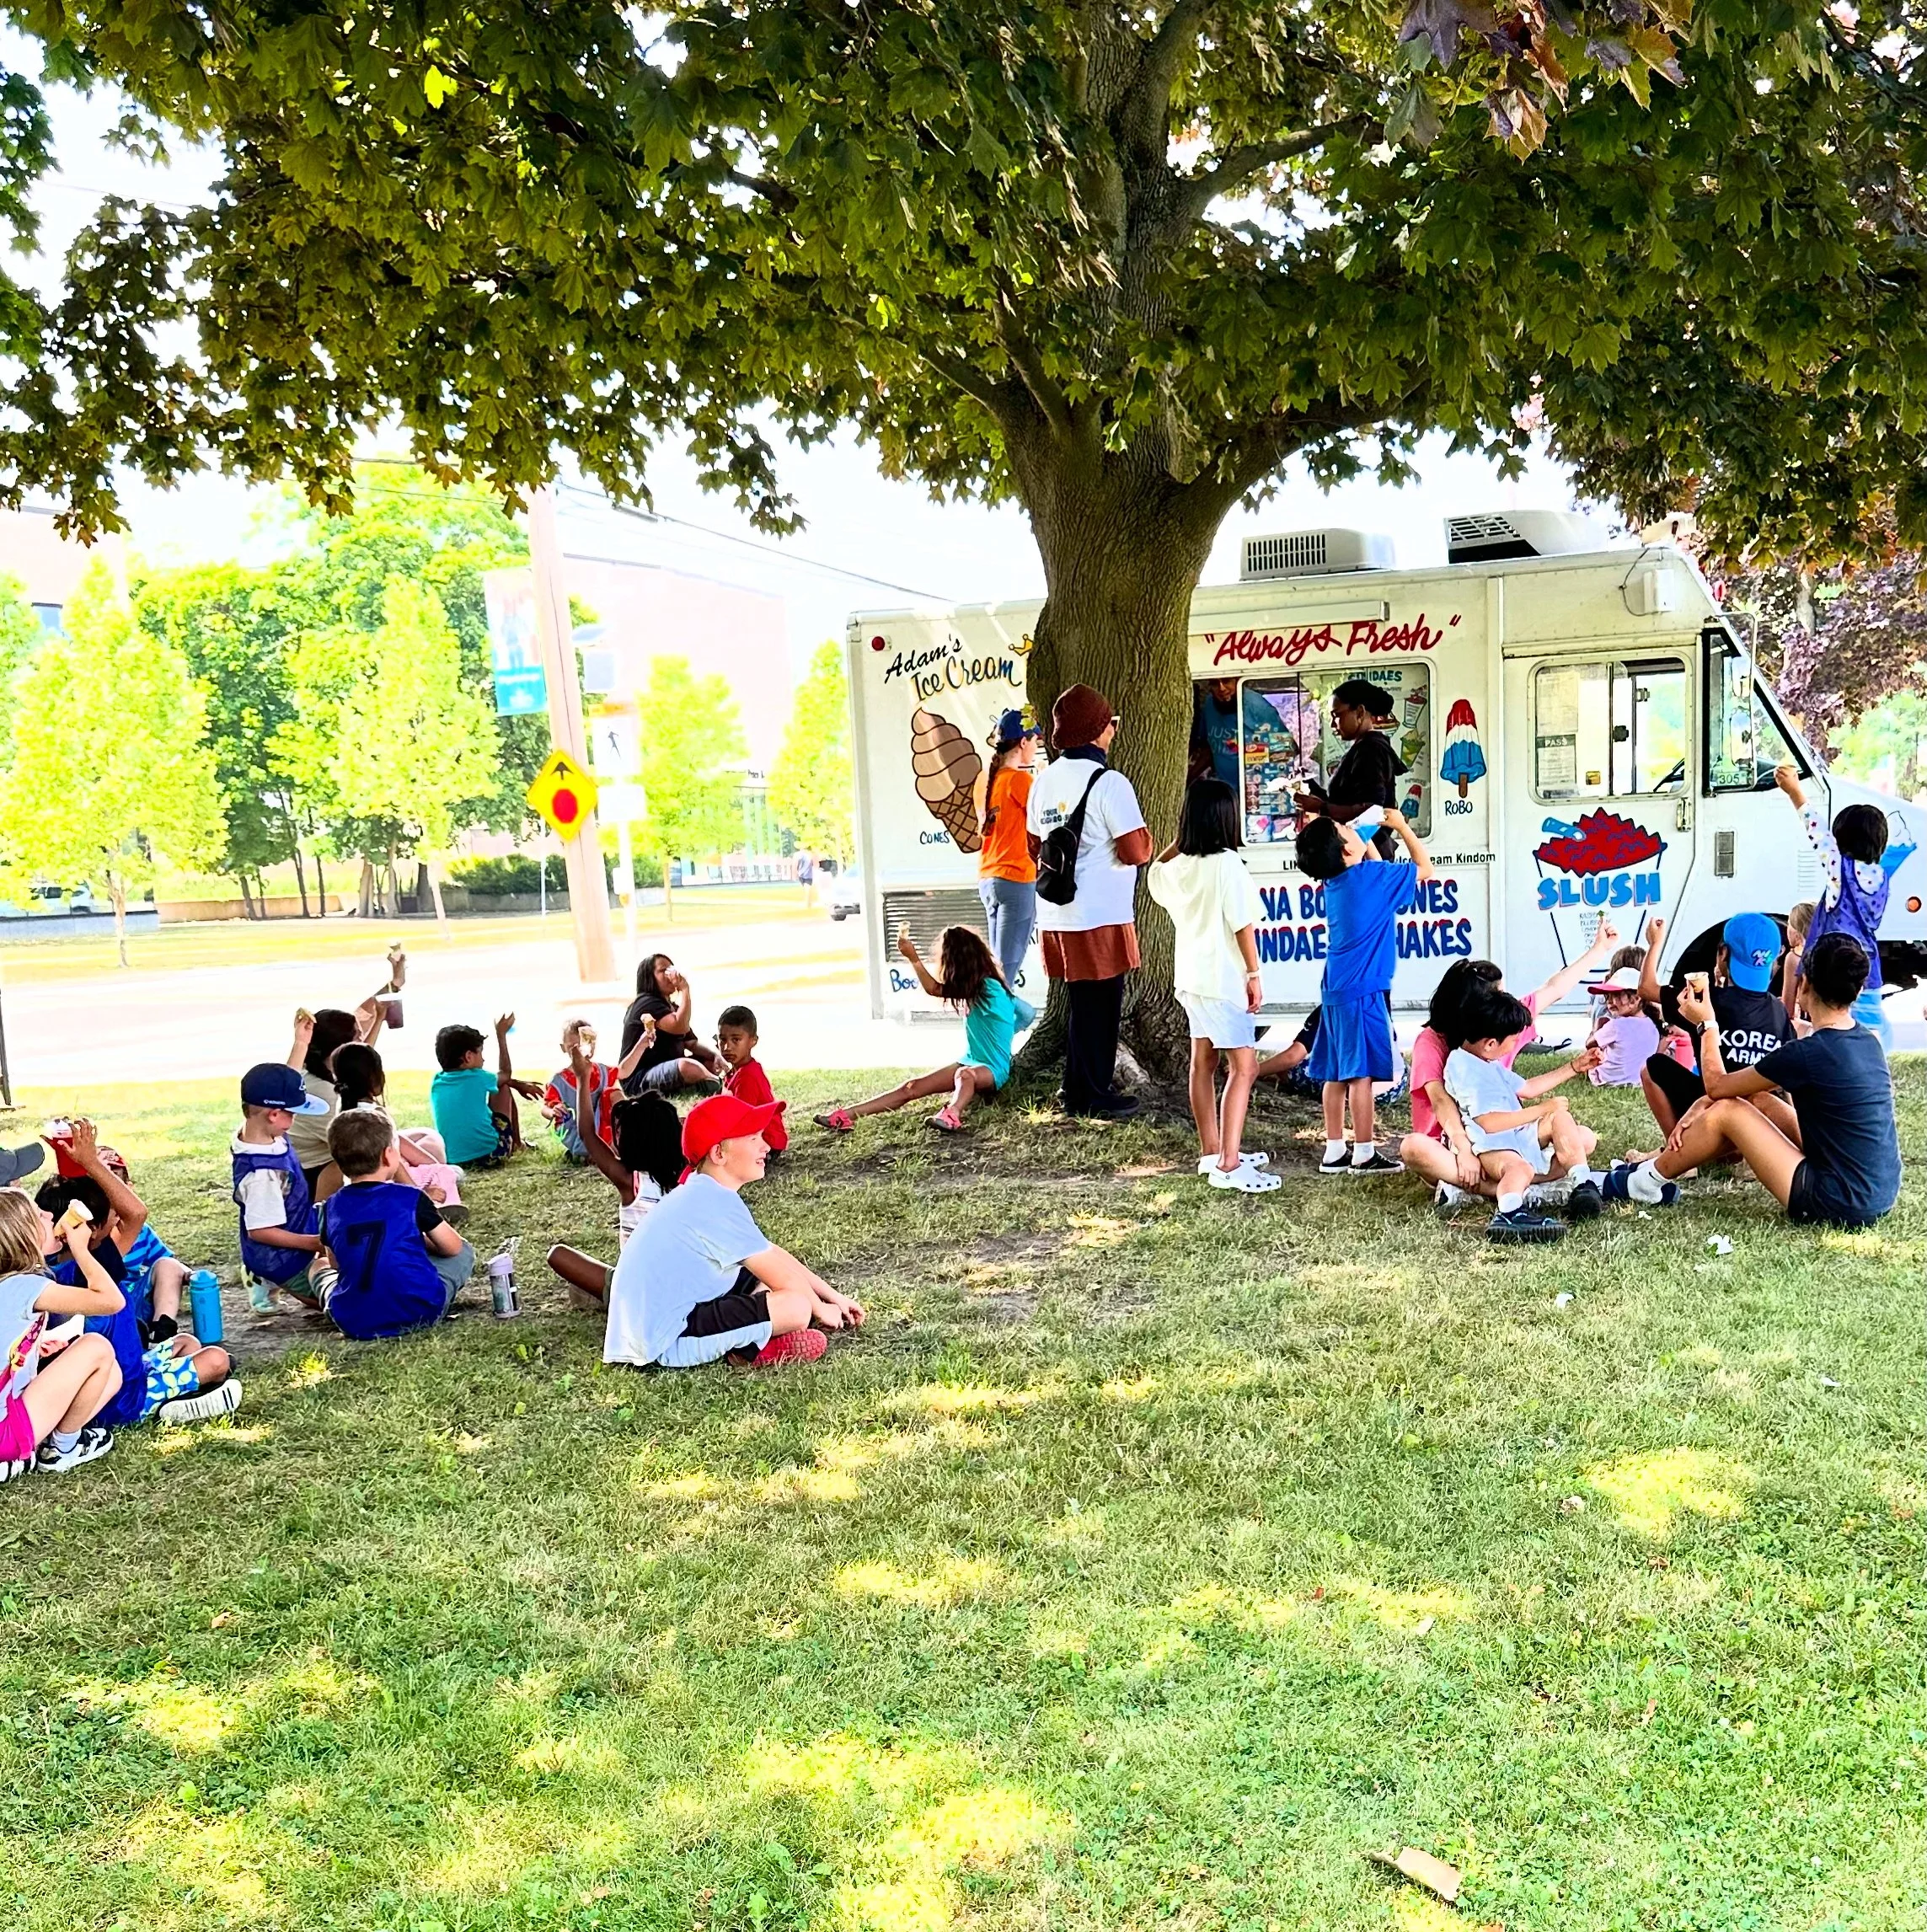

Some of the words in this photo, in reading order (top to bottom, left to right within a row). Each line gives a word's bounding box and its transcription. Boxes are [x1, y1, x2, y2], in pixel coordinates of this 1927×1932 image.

[885, 634, 962, 684] Adam's
[911, 672, 945, 702] Ice
[945, 656, 1023, 689] Cream
[1544, 737, 1568, 747] PASS
[1719, 773, 1740, 785] 305
[919, 830, 950, 844] CONES
[1430, 855, 1453, 865] eam
[1456, 853, 1496, 864] Kindom
[1395, 879, 1459, 916] NES
[1537, 872, 1662, 911] SLUSH
[1395, 918, 1473, 959] HAKES
[346, 1220, 387, 1293] 7
